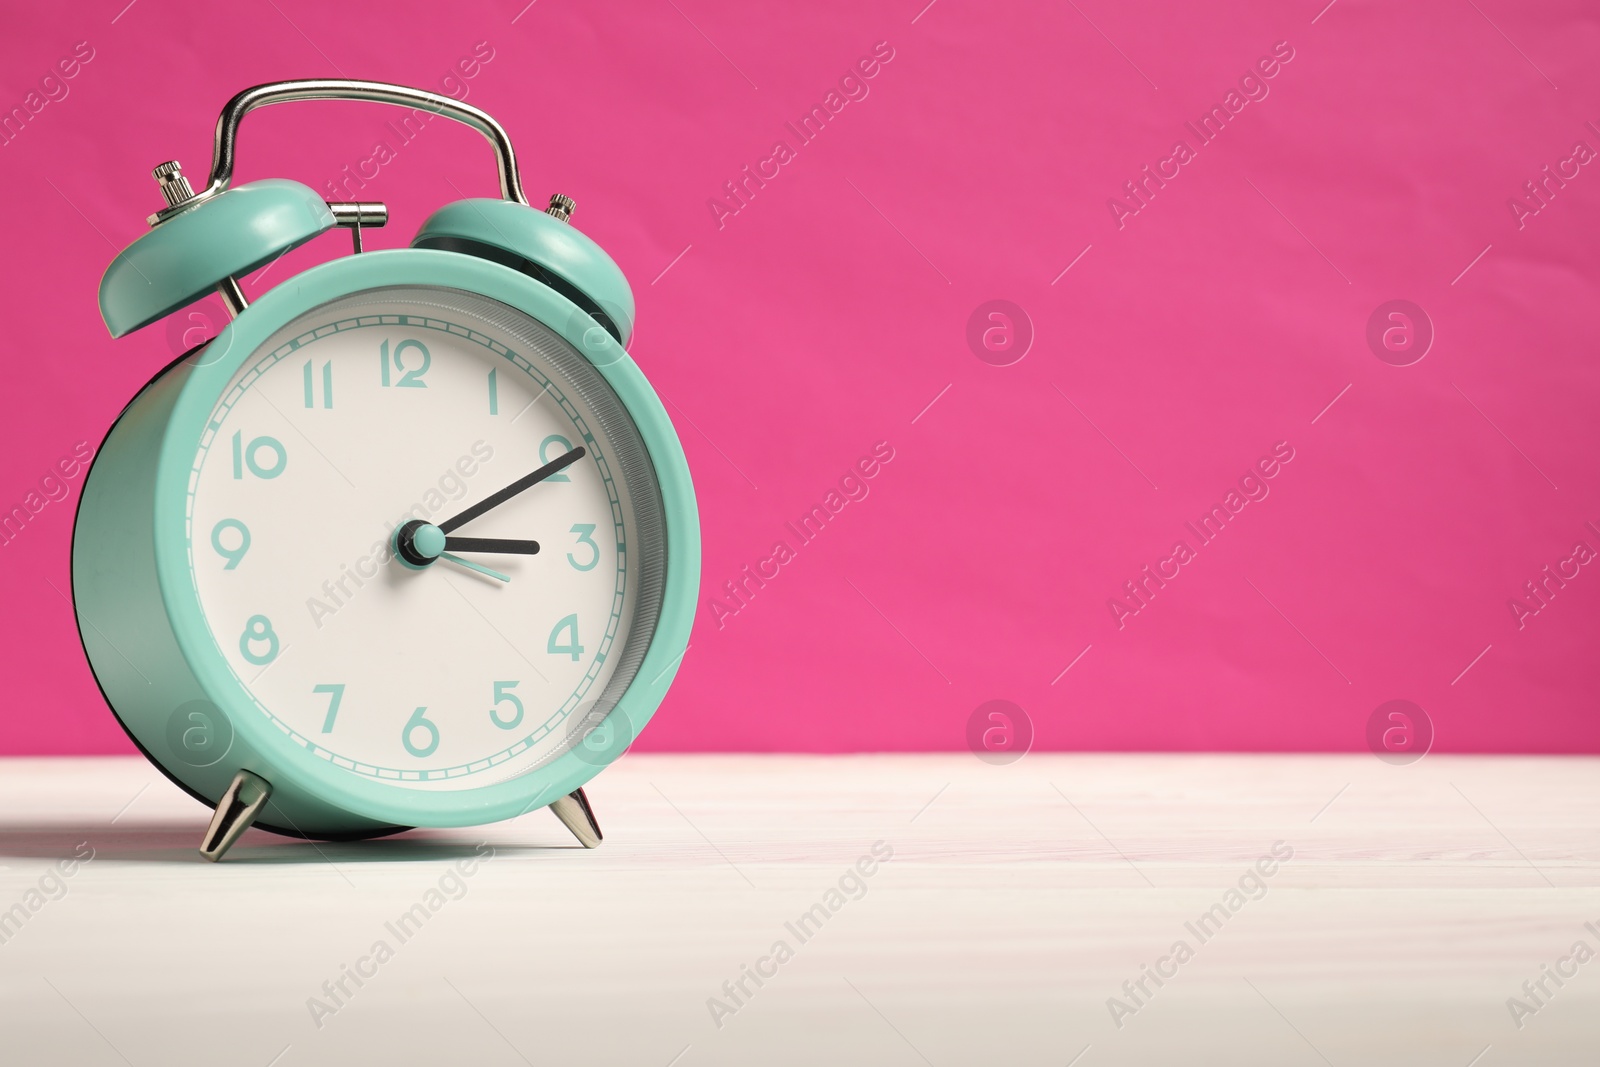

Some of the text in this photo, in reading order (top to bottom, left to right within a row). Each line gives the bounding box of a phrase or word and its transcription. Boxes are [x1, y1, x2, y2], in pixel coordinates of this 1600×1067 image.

[303, 359, 333, 409] 11
[380, 338, 431, 388] 12
[488, 367, 498, 415] 1
[232, 429, 287, 480] 10
[211, 518, 251, 570] 9
[566, 523, 600, 572] 3
[239, 614, 279, 666] 8
[547, 613, 584, 661] 4
[312, 684, 346, 733] 7
[489, 680, 524, 730] 5
[402, 706, 440, 758] 6
